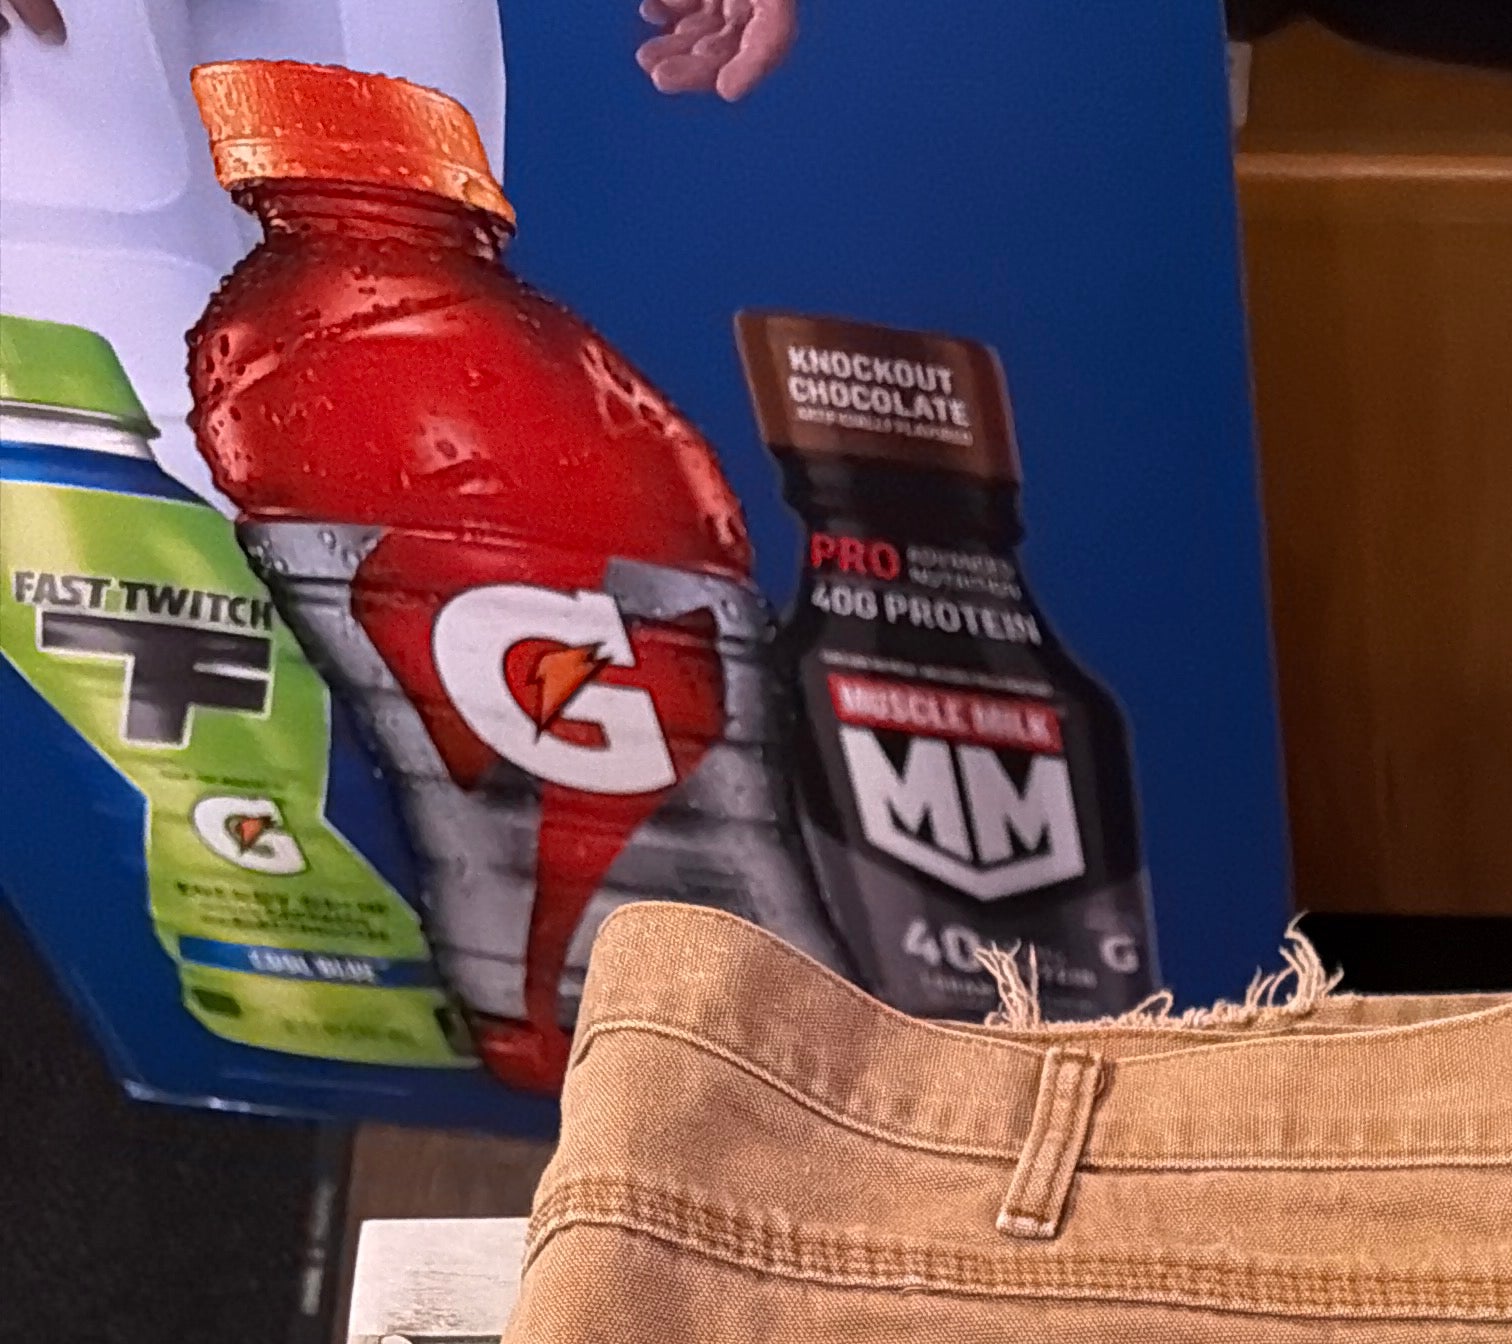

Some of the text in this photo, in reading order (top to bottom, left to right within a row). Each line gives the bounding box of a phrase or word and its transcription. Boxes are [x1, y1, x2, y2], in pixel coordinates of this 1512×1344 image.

[787, 345, 954, 394] KNOCKOUT
[787, 374, 971, 428] CHOCOLATE
[810, 531, 900, 582] PRO
[14, 571, 275, 632] FAST TWITCH
[883, 591, 1043, 646] PROTEIN
[431, 582, 678, 796] G
